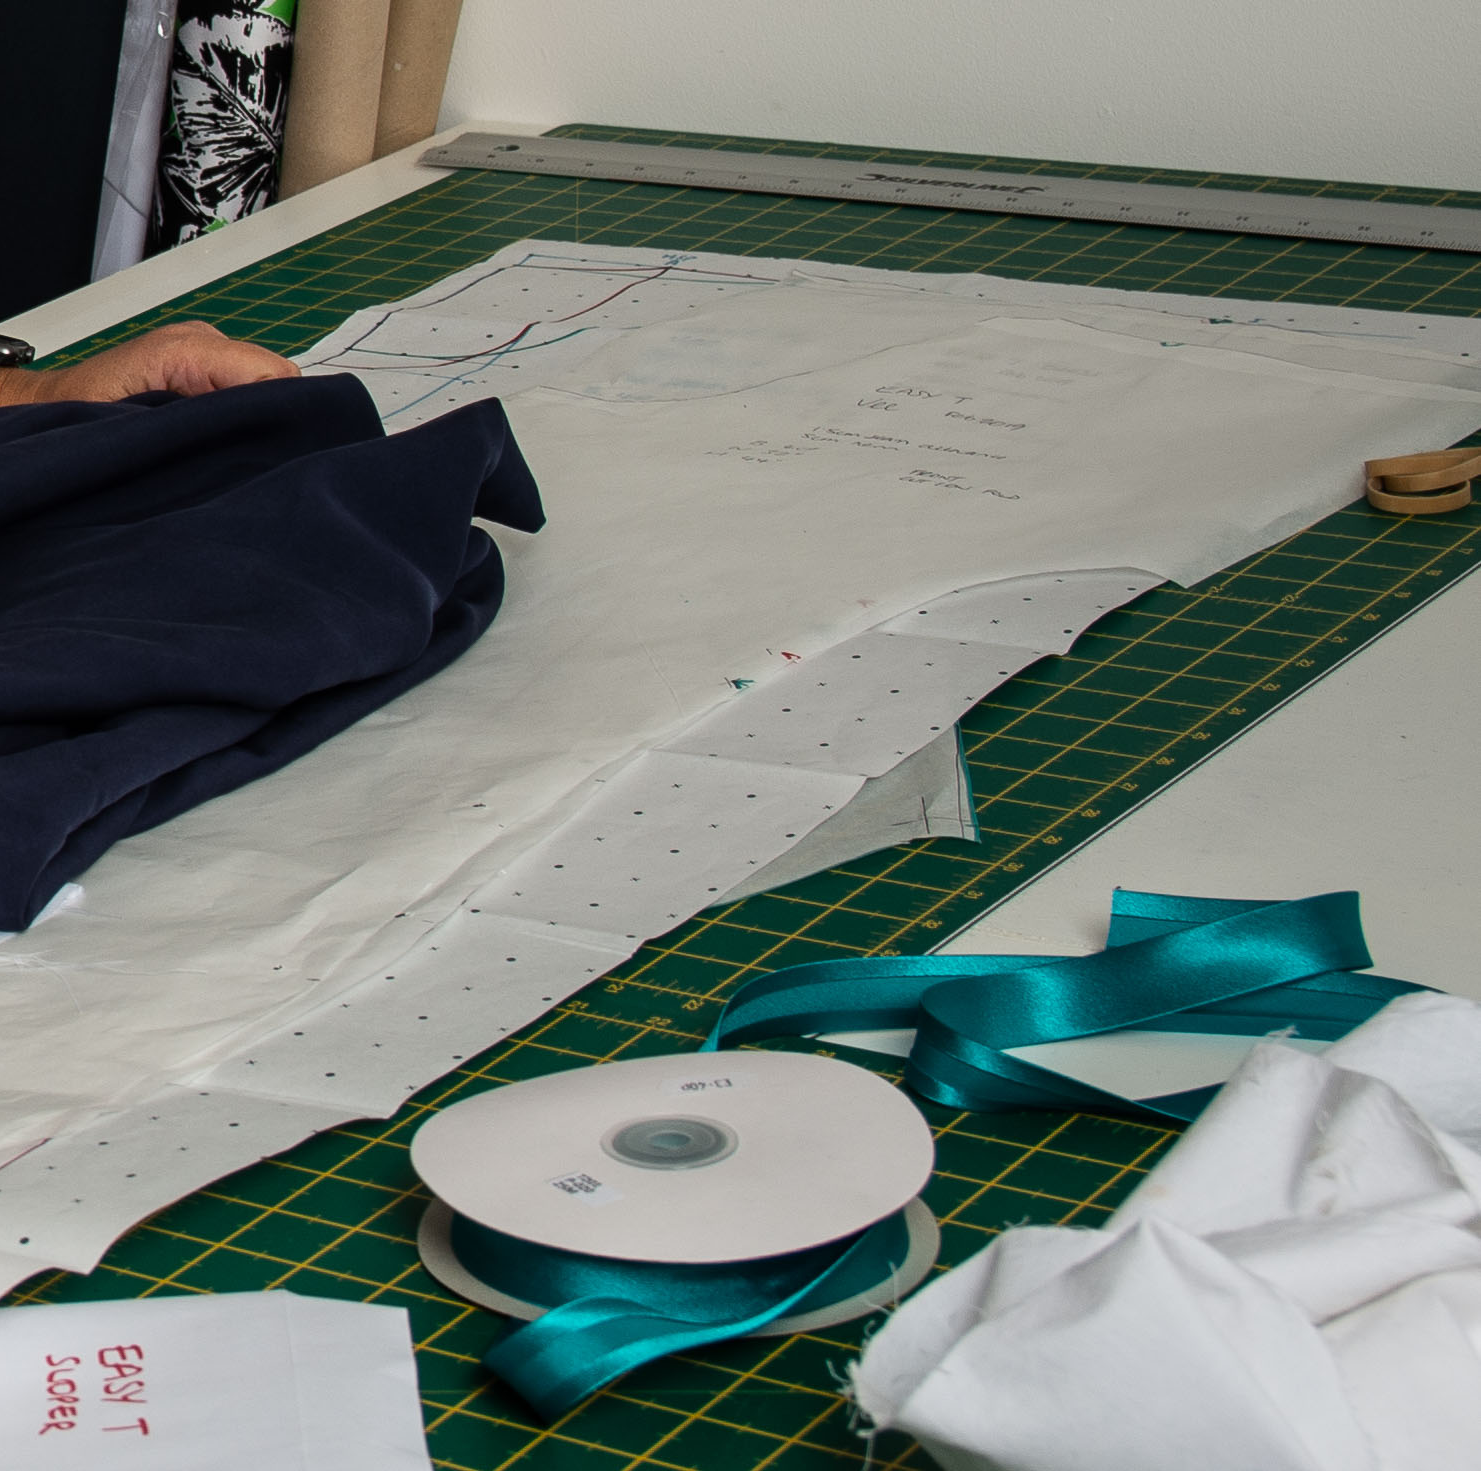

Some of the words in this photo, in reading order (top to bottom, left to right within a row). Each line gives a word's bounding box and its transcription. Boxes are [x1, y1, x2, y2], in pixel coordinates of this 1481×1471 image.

[38, 1354, 81, 1435] SLOPER
[98, 1344, 148, 1403] EASY
[101, 1417, 150, 1436] T
